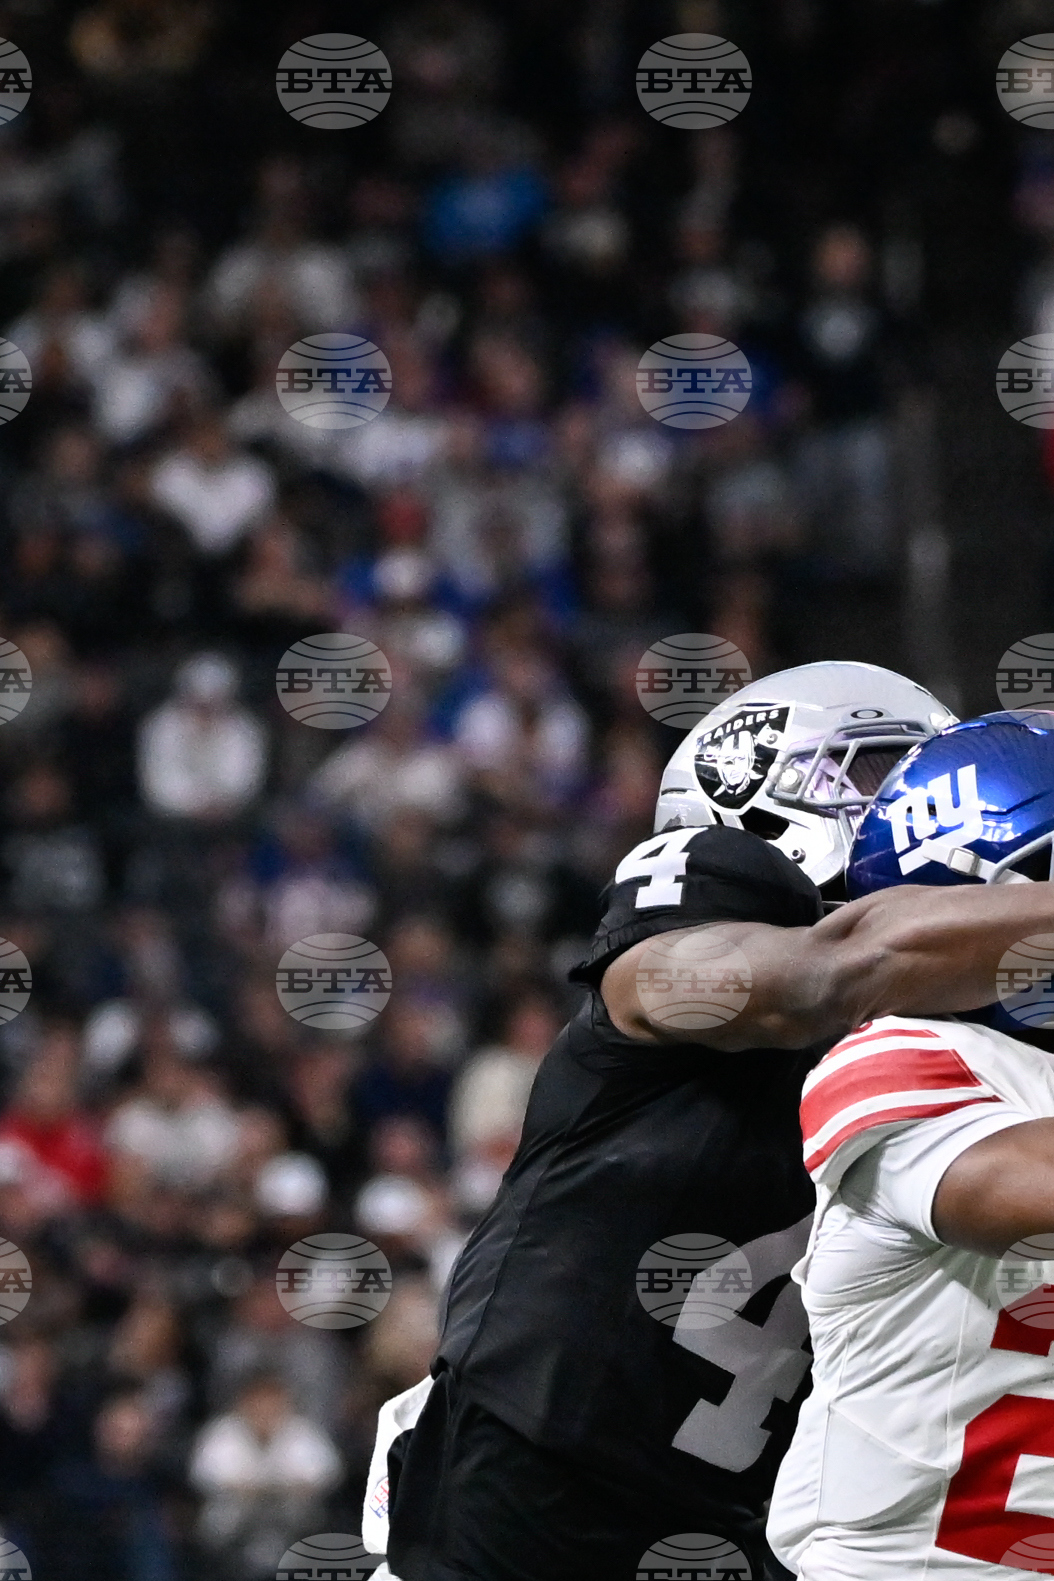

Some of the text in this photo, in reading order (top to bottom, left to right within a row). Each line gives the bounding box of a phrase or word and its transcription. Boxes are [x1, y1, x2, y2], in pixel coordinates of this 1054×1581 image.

[703, 709, 780, 744] RAIDERS
[615, 827, 709, 908] 4
[671, 1210, 815, 1473] 4
